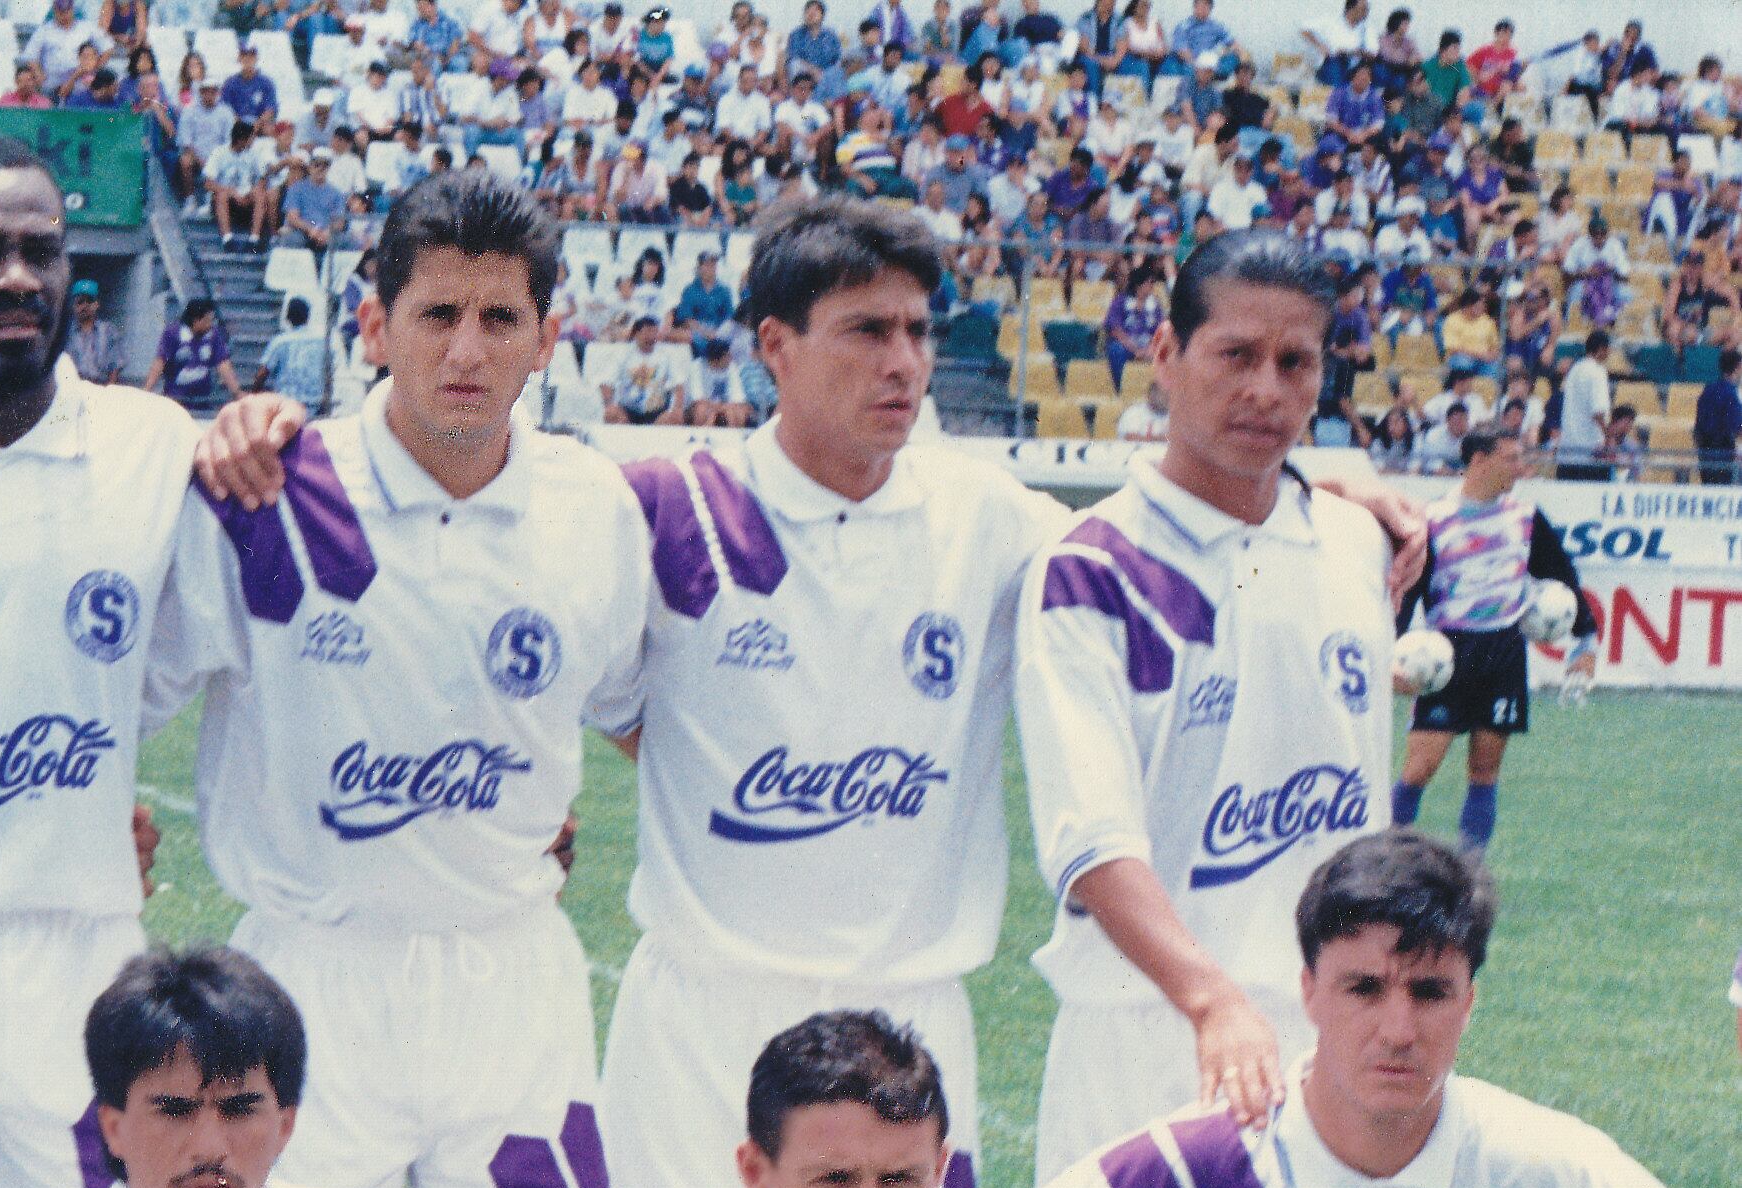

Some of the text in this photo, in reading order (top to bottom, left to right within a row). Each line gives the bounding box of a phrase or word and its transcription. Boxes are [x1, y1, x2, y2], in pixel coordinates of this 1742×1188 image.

[89, 586, 124, 645] S
[510, 626, 545, 681] S
[923, 628, 954, 682] S
[1337, 643, 1369, 698] S
[322, 739, 532, 815] Coca-Cola
[732, 746, 949, 818] Coca-Cola
